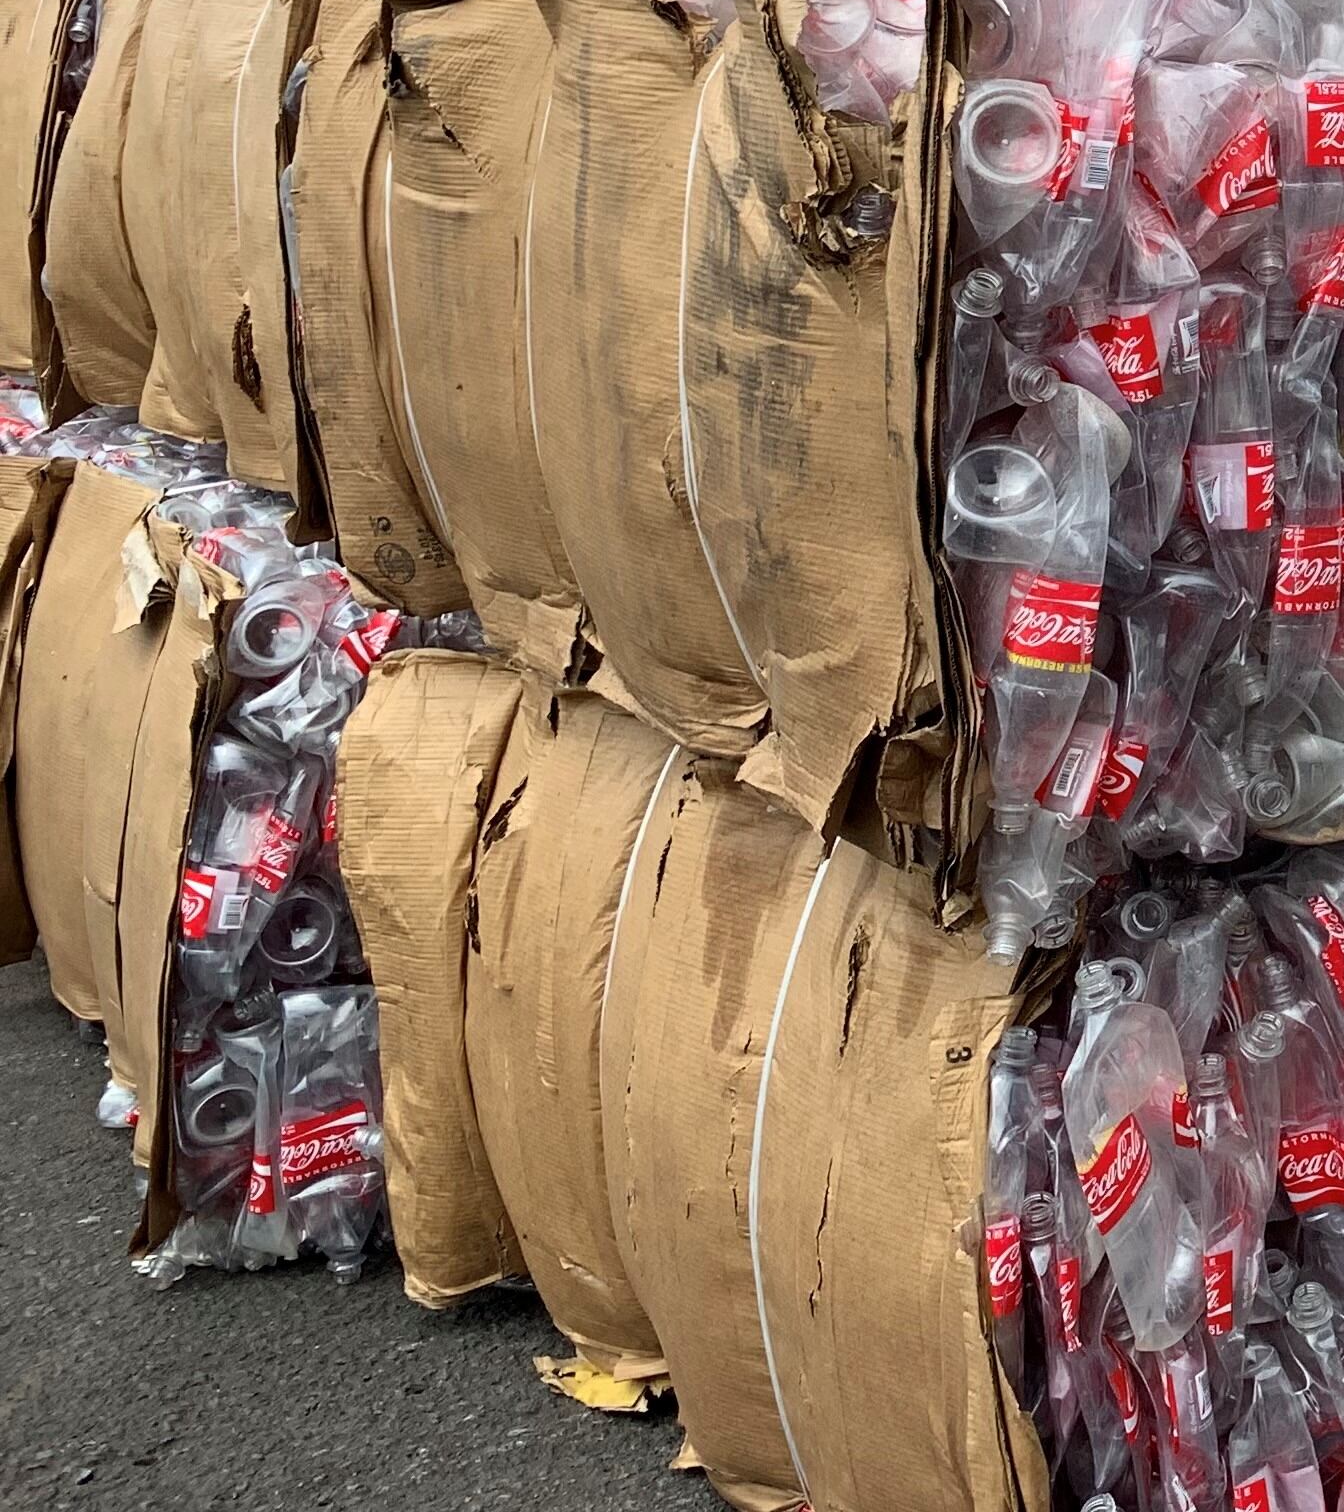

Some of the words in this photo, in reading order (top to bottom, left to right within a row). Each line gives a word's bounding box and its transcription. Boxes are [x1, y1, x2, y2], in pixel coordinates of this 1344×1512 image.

[1314, 83, 1336, 94] 2.5L
[1206, 120, 1267, 176] RETORNA
[1256, 444, 1273, 456] 5L
